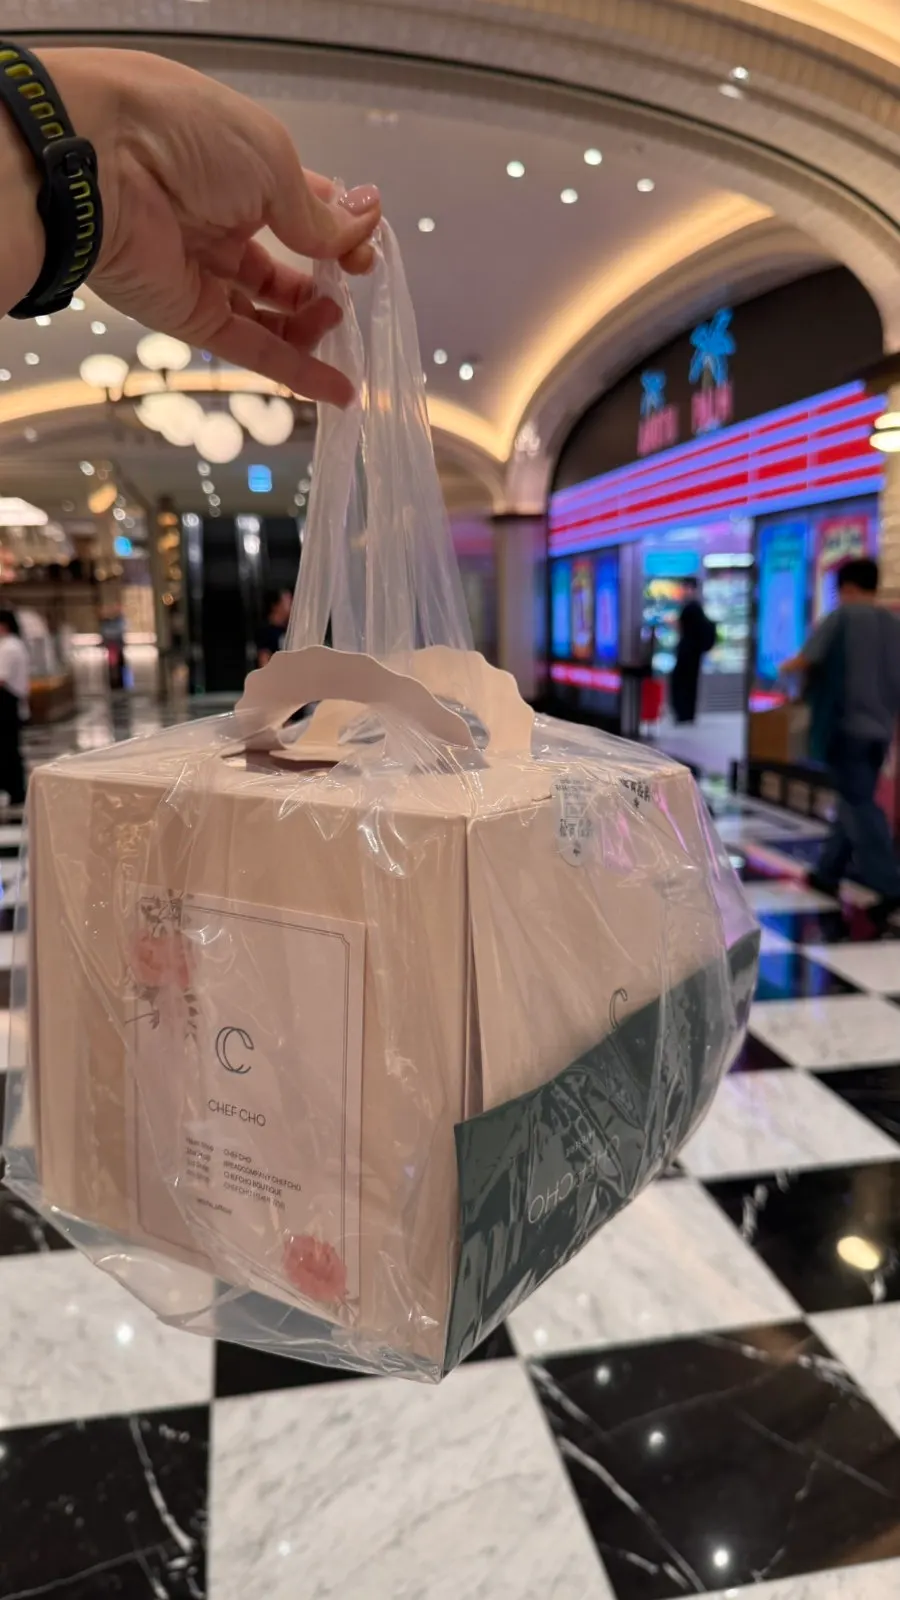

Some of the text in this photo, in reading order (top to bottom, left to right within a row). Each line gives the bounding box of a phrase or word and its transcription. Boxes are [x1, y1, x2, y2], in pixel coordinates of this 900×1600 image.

[208, 1099, 267, 1127] CHEF CHO
[528, 1172, 574, 1224] CHO
